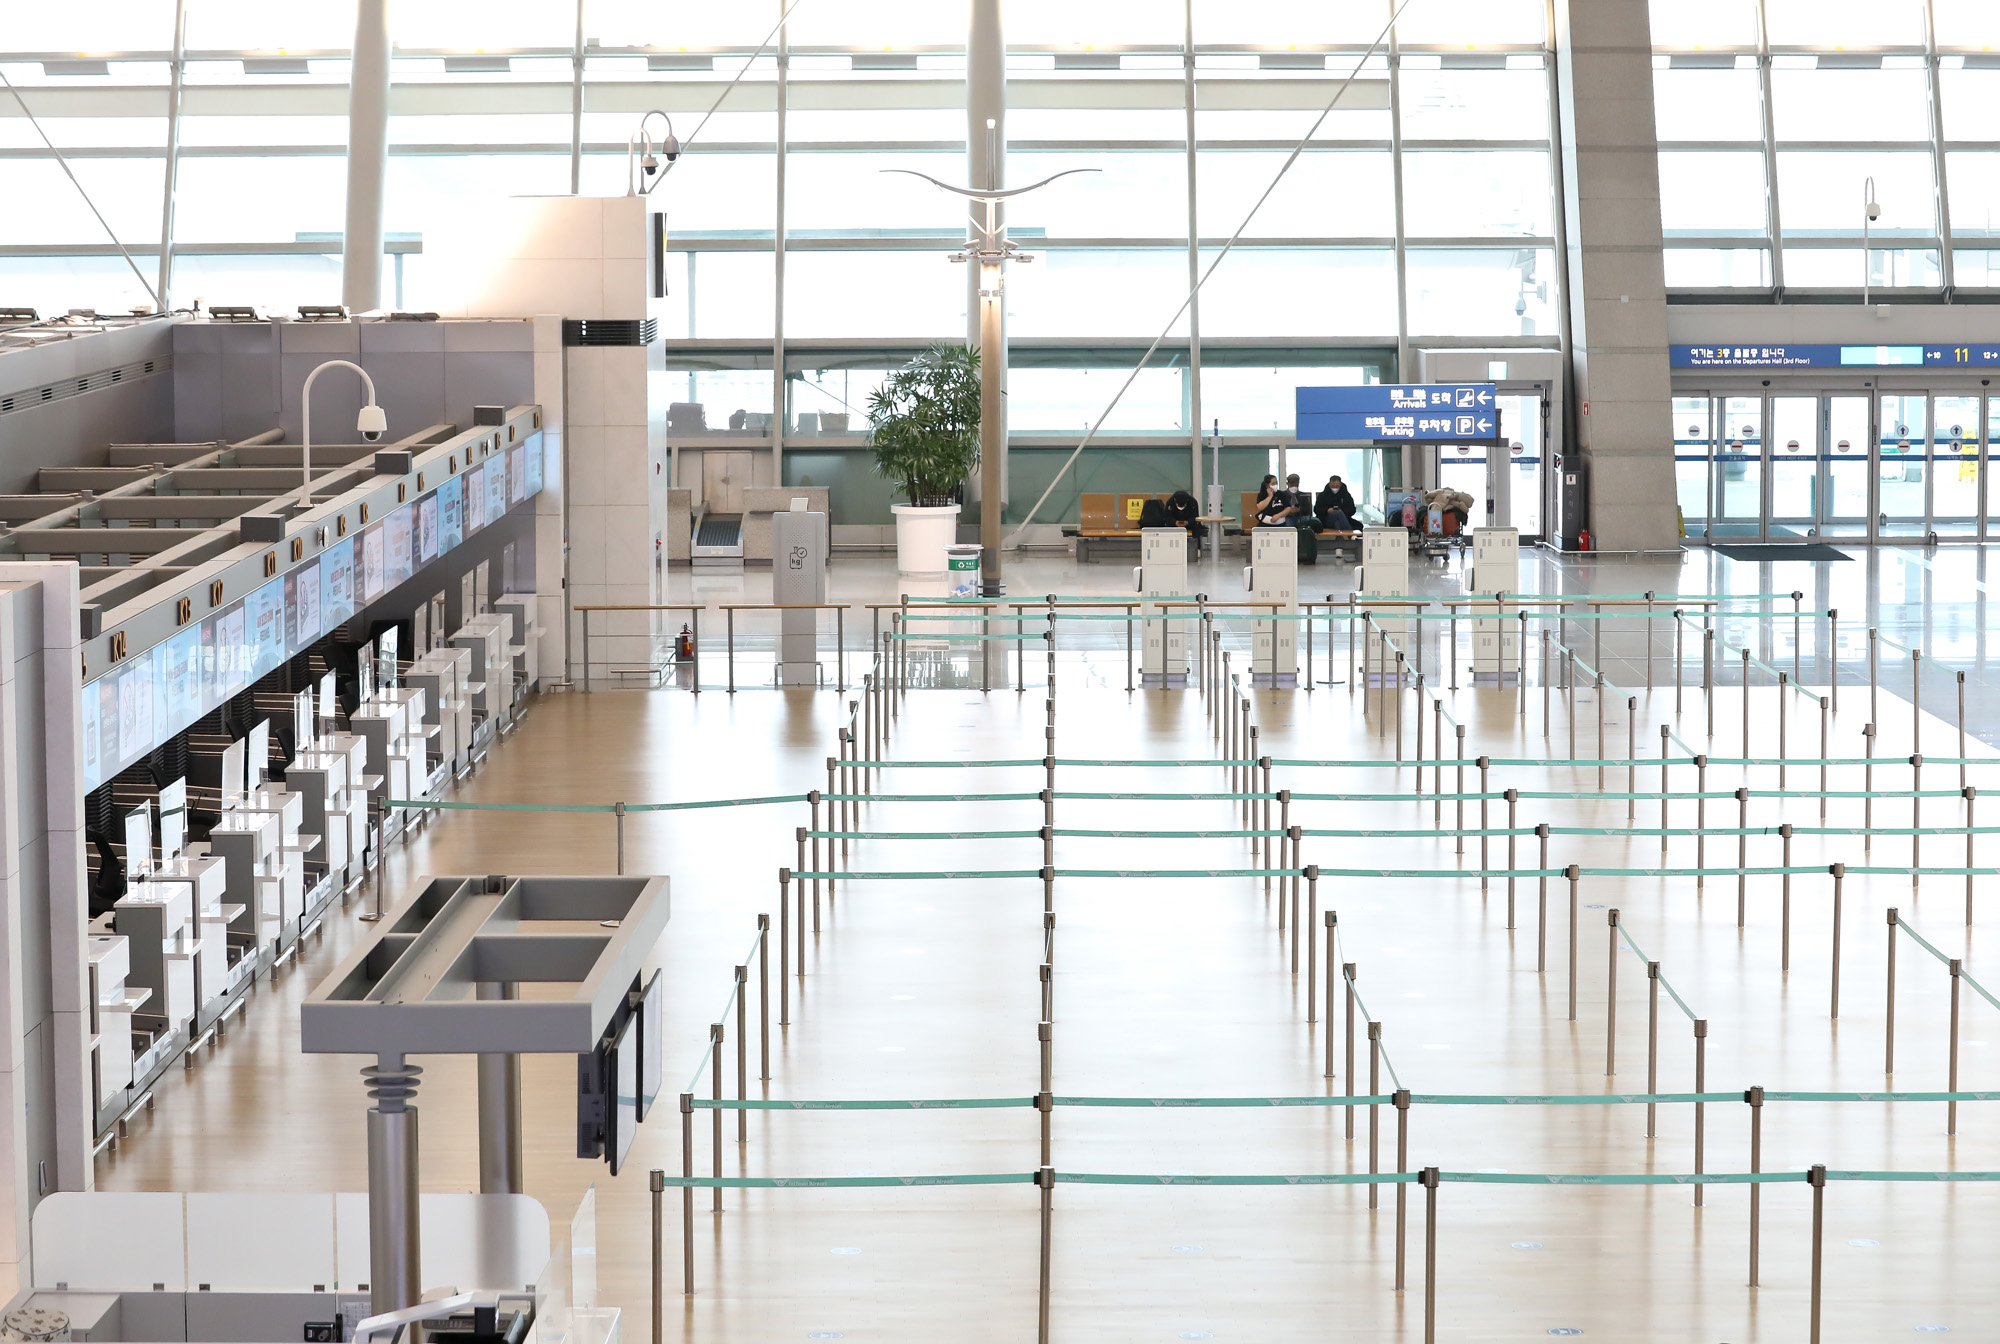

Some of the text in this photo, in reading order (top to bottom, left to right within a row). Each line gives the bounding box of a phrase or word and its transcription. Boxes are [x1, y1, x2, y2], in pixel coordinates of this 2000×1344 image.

[1690, 348, 1714, 358] 여기는
[1762, 348, 1785, 358] 입니다
[1933, 351, 1942, 359] 10
[1953, 347, 1969, 363] 11
[1983, 351, 1991, 359] 12
[1393, 399, 1427, 409] Arrivals
[1430, 392, 1452, 405] 도착
[1418, 419, 1452, 433] 주차장
[1381, 427, 1415, 438] Parking
[791, 558, 801, 566] kg
[177, 595, 192, 627] K13
[110, 630, 127, 663] K14
